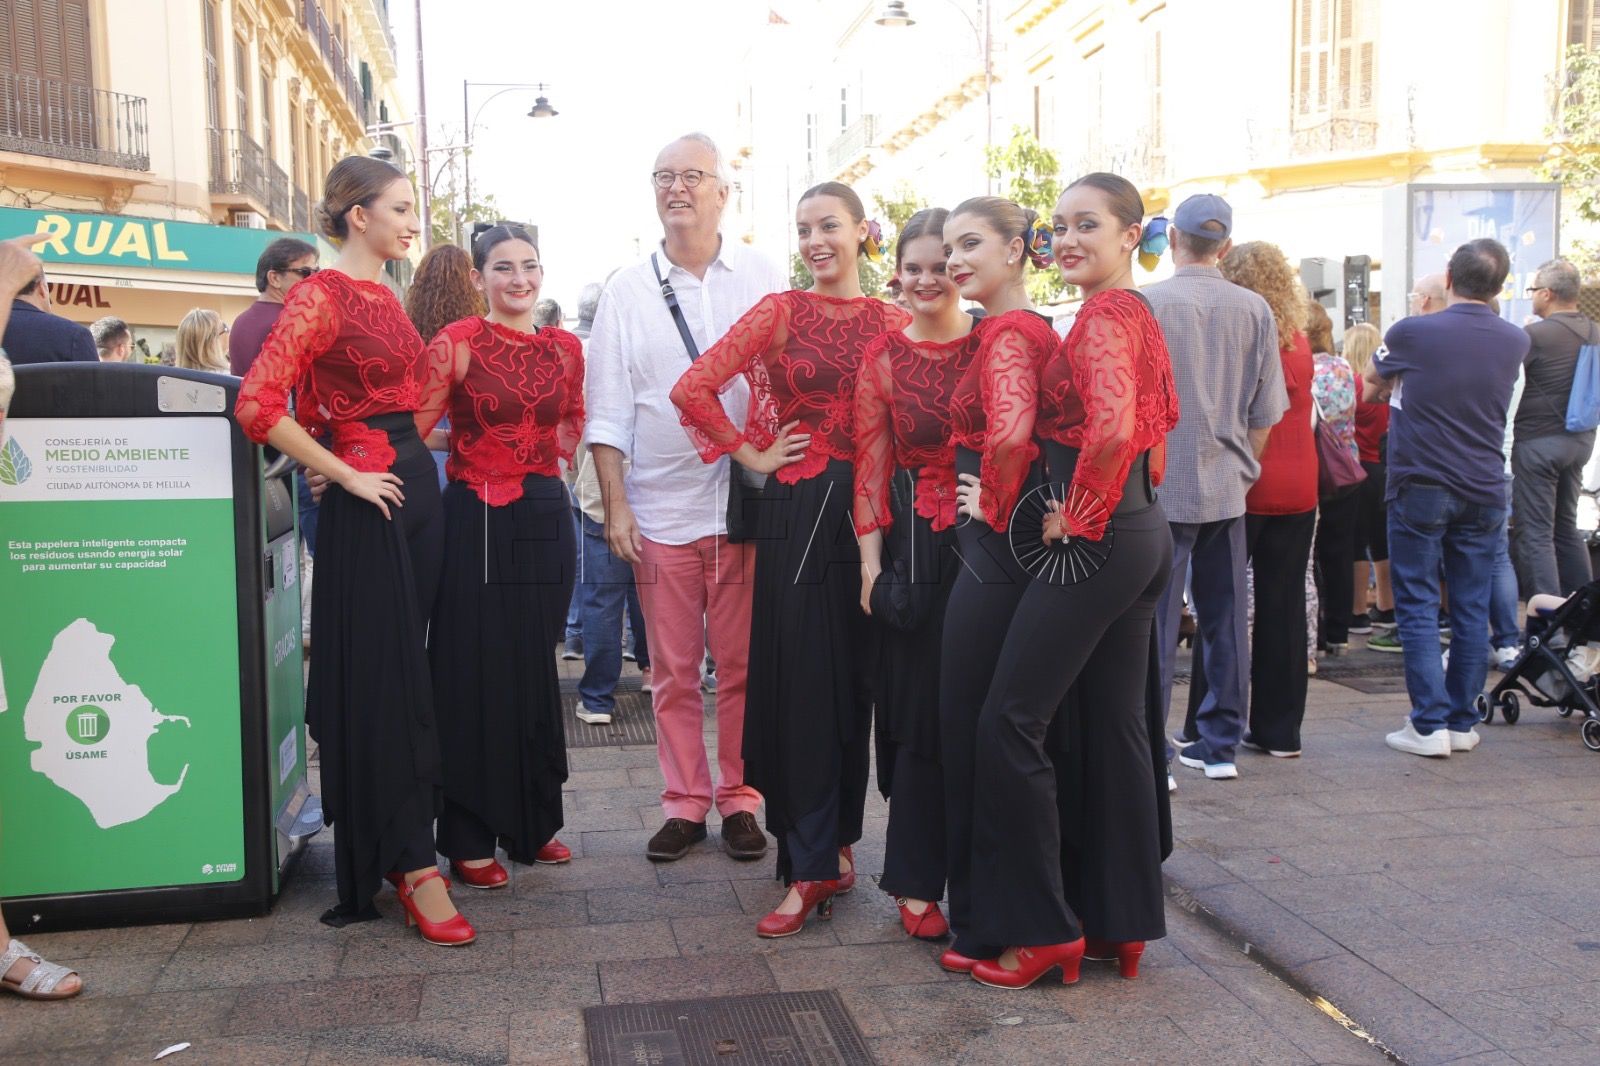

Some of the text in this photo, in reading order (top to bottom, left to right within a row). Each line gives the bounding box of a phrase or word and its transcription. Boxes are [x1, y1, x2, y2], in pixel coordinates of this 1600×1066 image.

[31, 215, 189, 261] RUAL
[45, 438, 128, 446] CONSEJERÍA DE
[45, 448, 189, 461] MEDIO AMBIENTE
[56, 464, 138, 473] SOSTENIBILIDAD
[46, 480, 191, 490] CIUDAD AUTÓNOMA DE MELILLA
[8, 538, 187, 550] Esta papelera inteligente compacta
[10, 552, 26, 560] los
[29, 551, 75, 560] residuos
[77, 550, 115, 559] usando
[158, 548, 183, 557] solar
[22, 563, 46, 572] para
[48, 562, 96, 571] aumentar
[115, 560, 167, 570] capacidad
[274, 626, 296, 667] GRACIAS
[53, 693, 121, 704] POR FAVOR
[65, 750, 107, 760] ÚSAME
